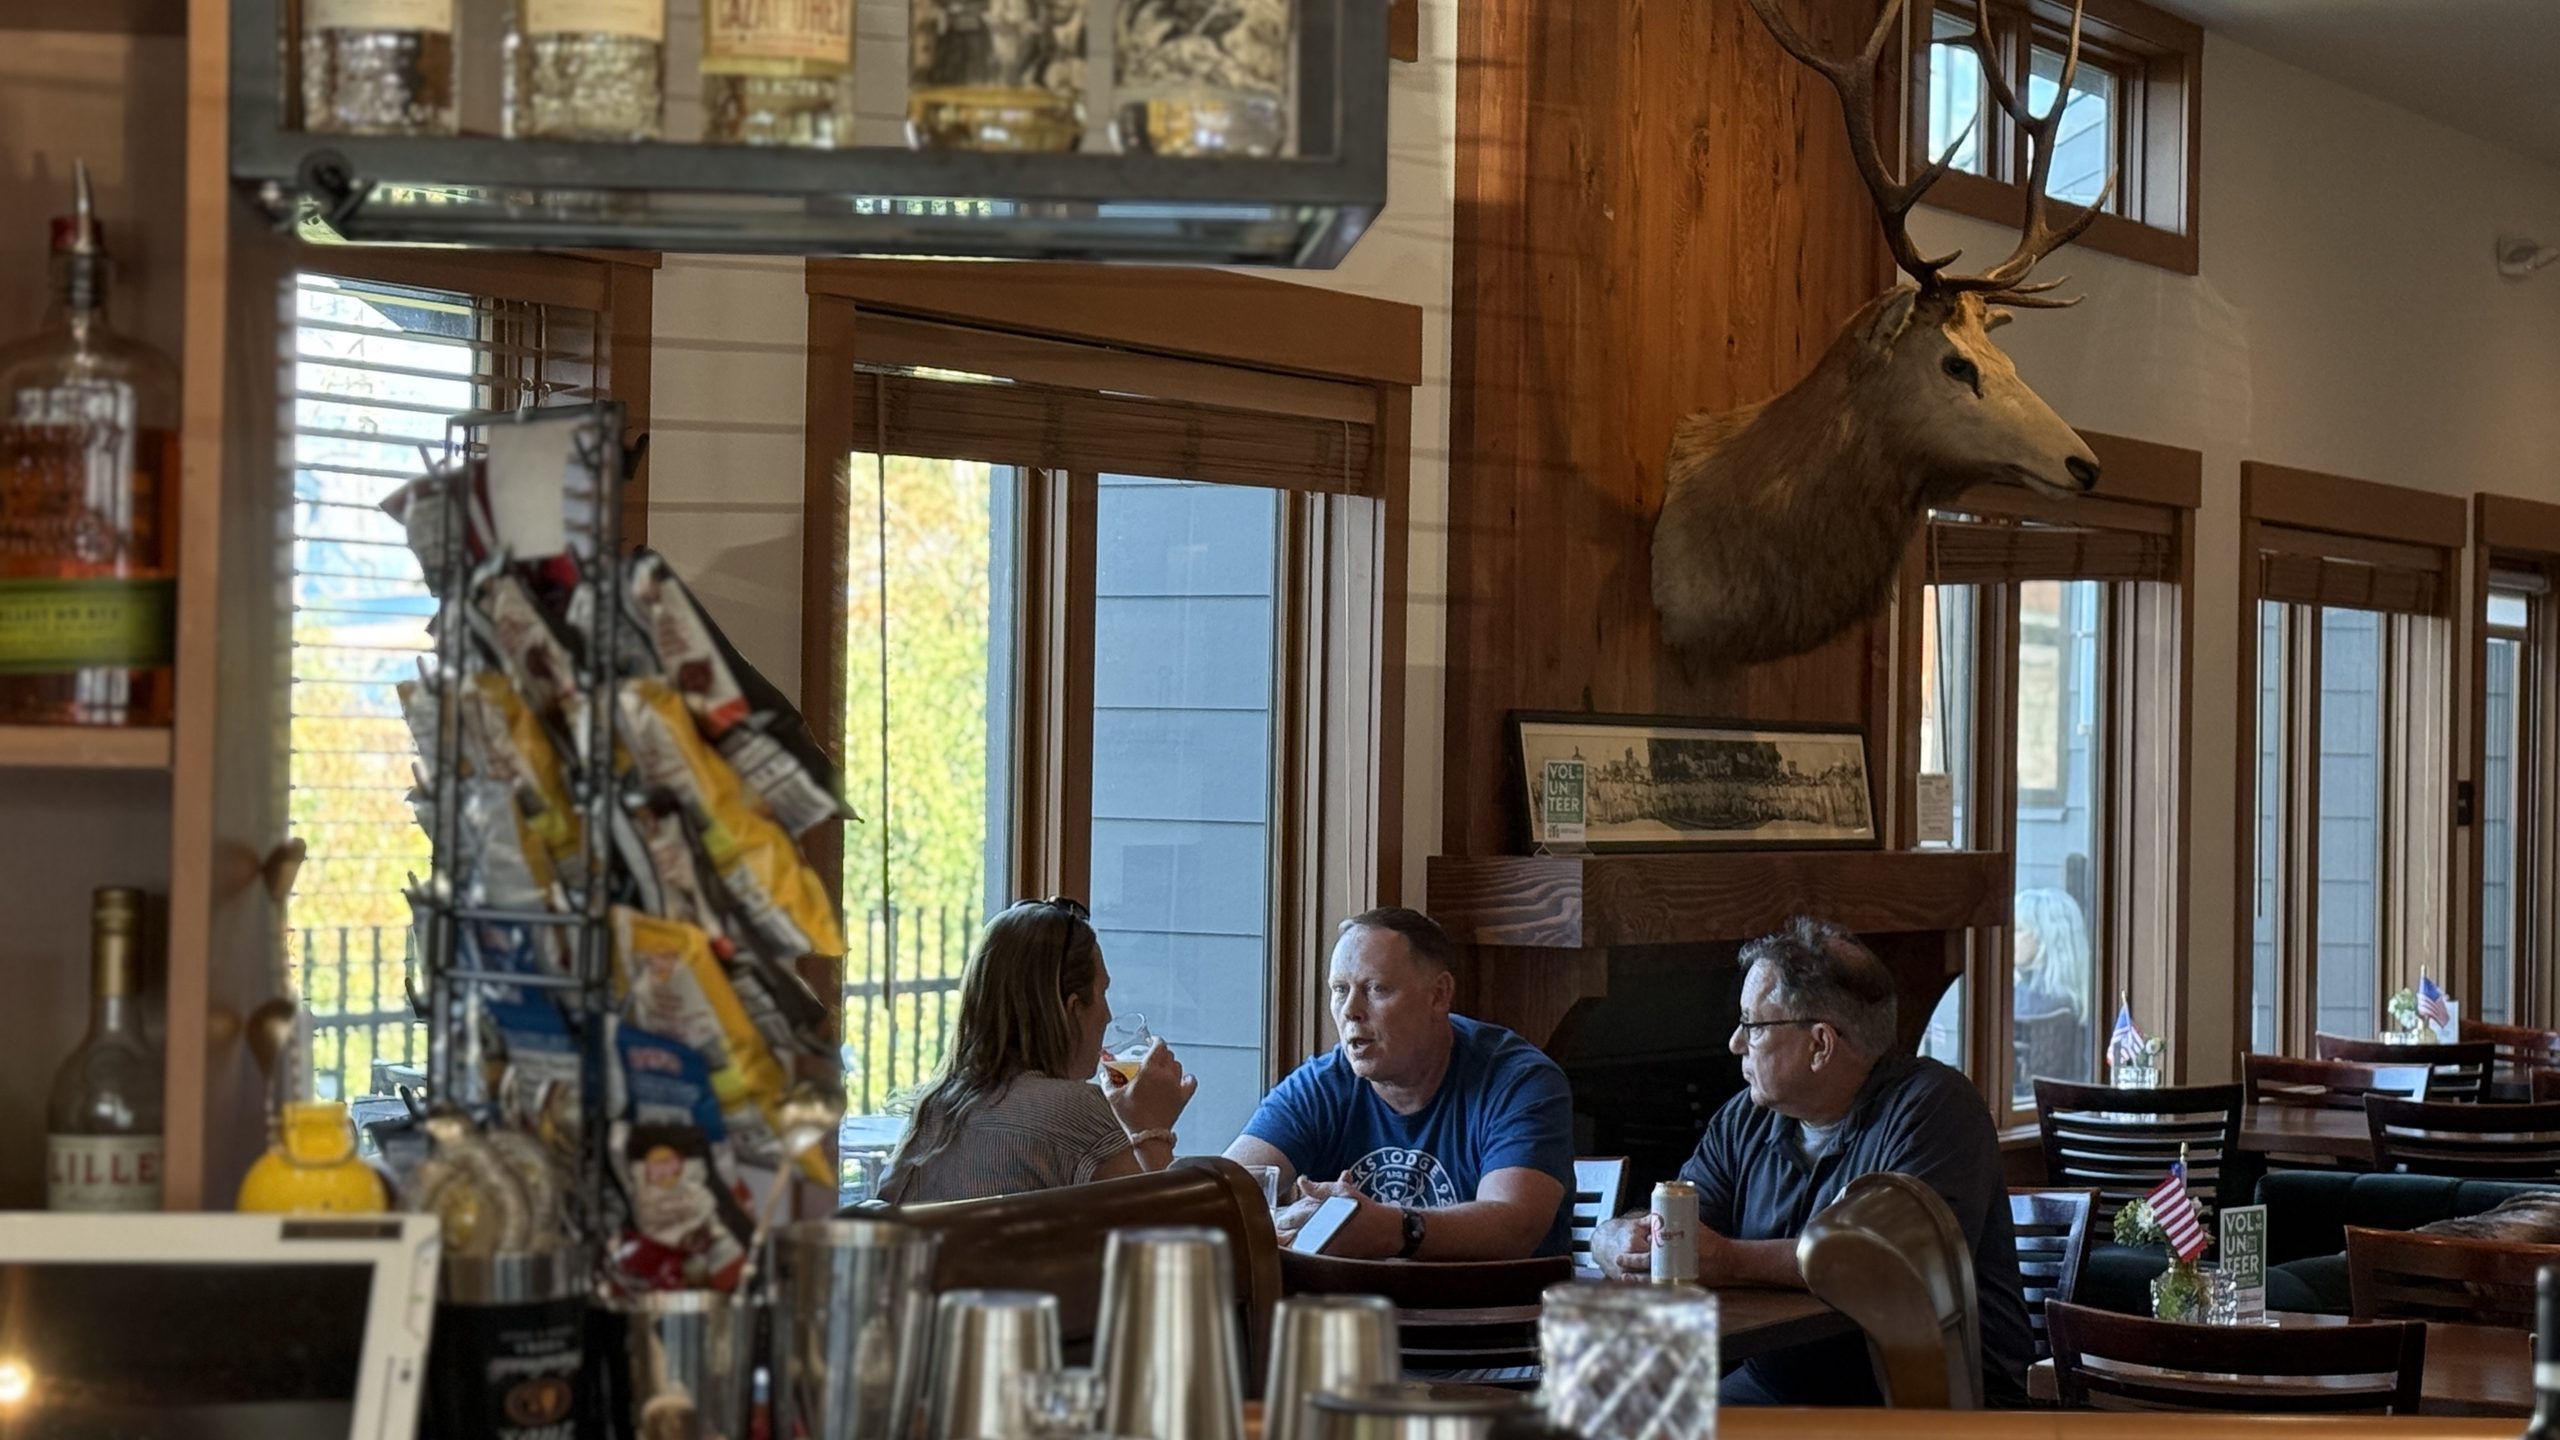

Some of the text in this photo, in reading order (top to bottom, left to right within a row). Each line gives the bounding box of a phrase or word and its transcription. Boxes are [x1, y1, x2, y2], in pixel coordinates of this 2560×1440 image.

[1548, 764, 1576, 779] VOL
[1548, 780, 1569, 796] UN
[1547, 796, 1580, 812] TEER
[1382, 1150, 1440, 1179] LODGE
[2224, 1212, 2255, 1235] VOL
[2225, 1234, 2247, 1256] UN
[2223, 1254, 2260, 1276] TEER
